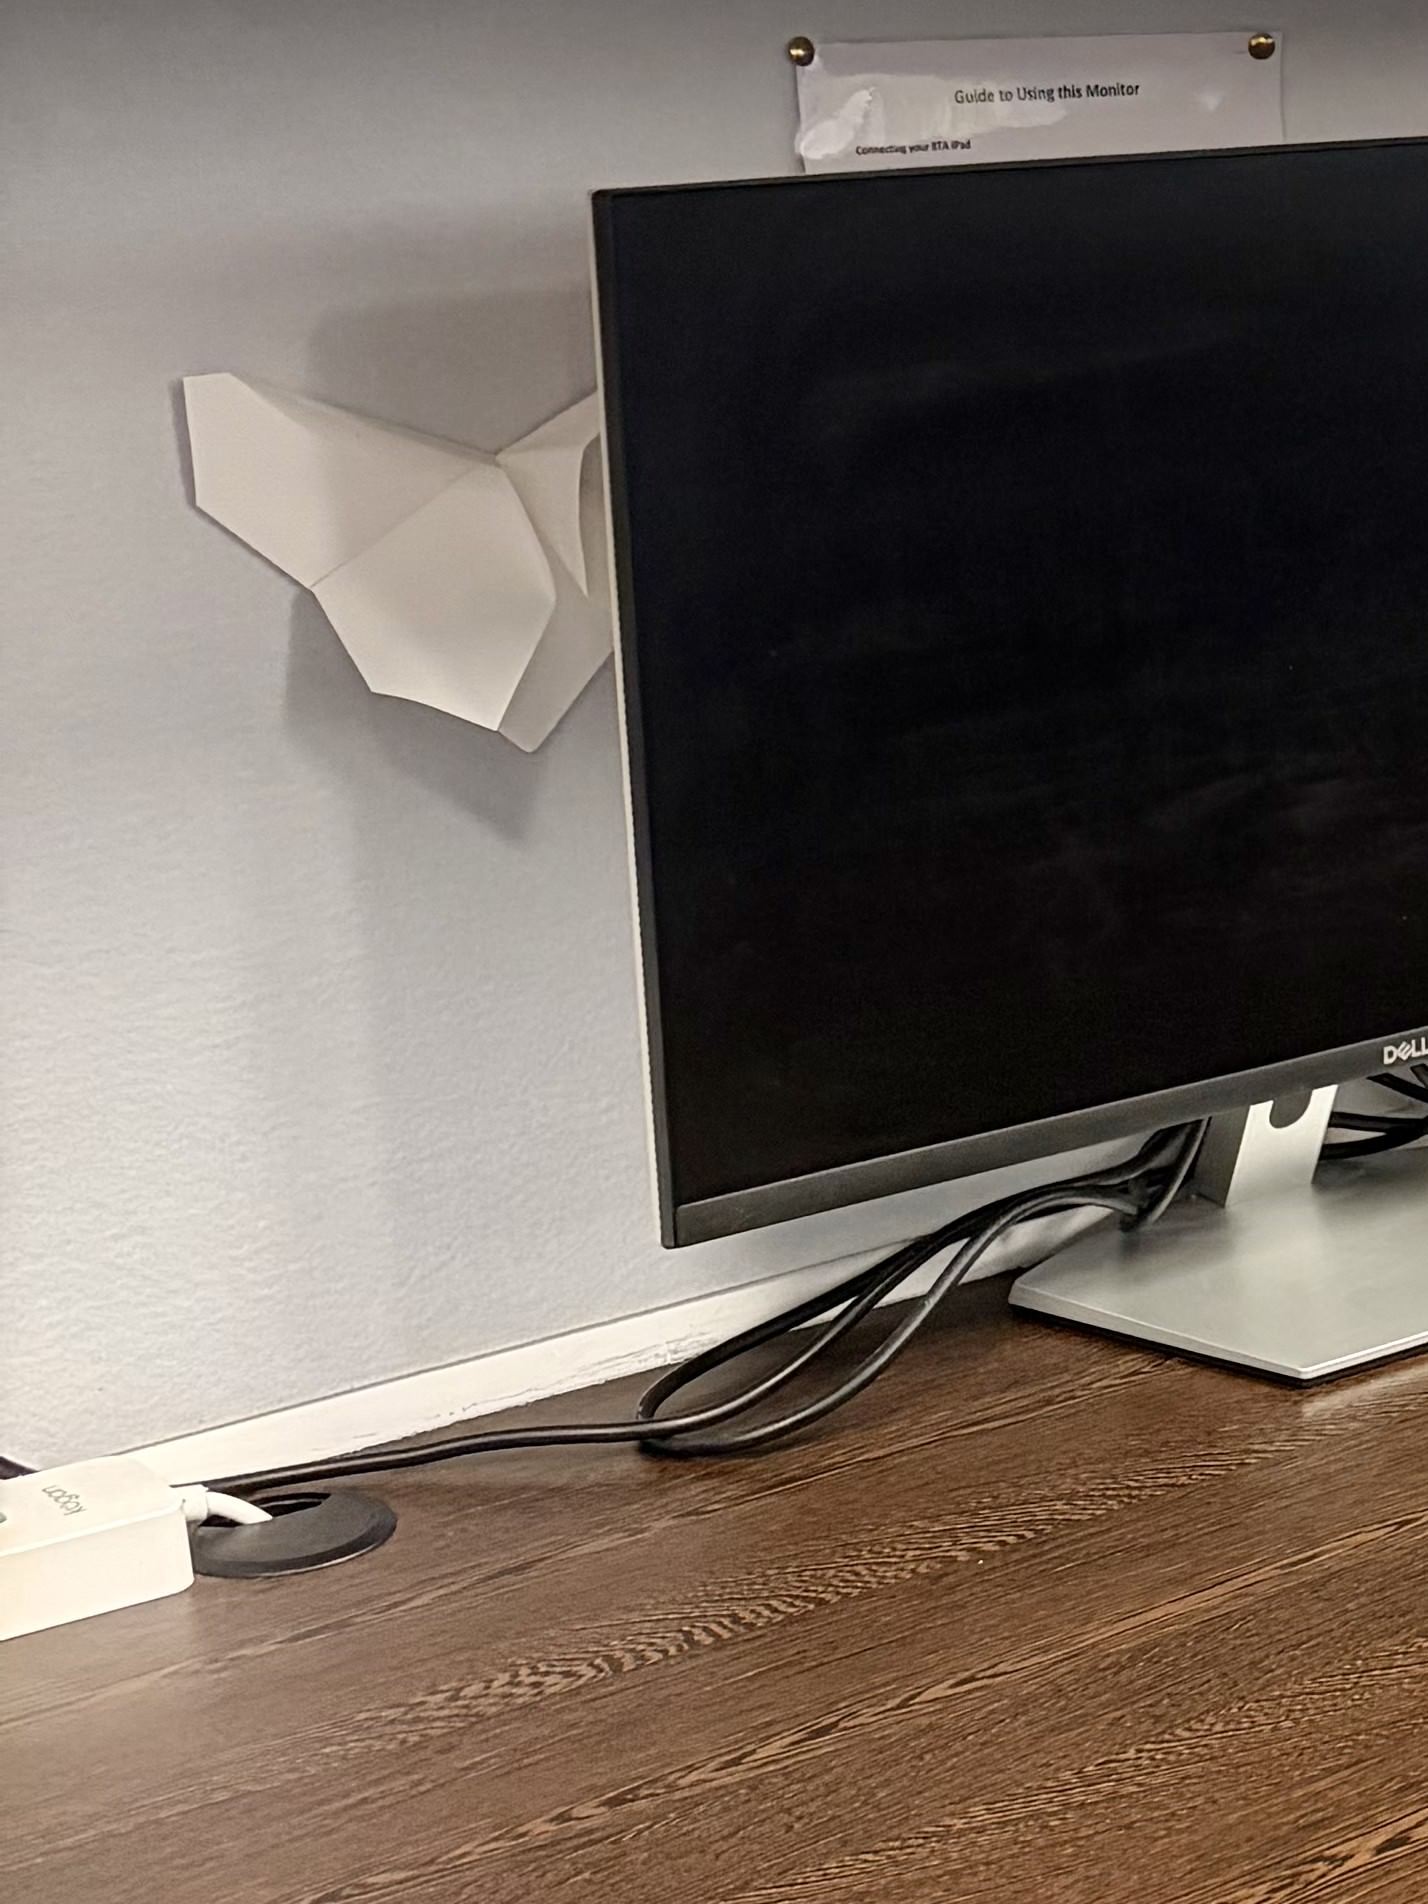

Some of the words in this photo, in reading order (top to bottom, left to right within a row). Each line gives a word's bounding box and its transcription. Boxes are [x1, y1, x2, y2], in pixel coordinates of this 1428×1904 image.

[954, 88, 995, 105] Guide
[999, 88, 1013, 102] to
[1016, 86, 1055, 104] Using
[1057, 84, 1083, 99] this
[1086, 82, 1140, 98] Monitor
[855, 143, 907, 156] Connecting
[908, 143, 929, 154] your
[951, 139, 971, 150] iPad
